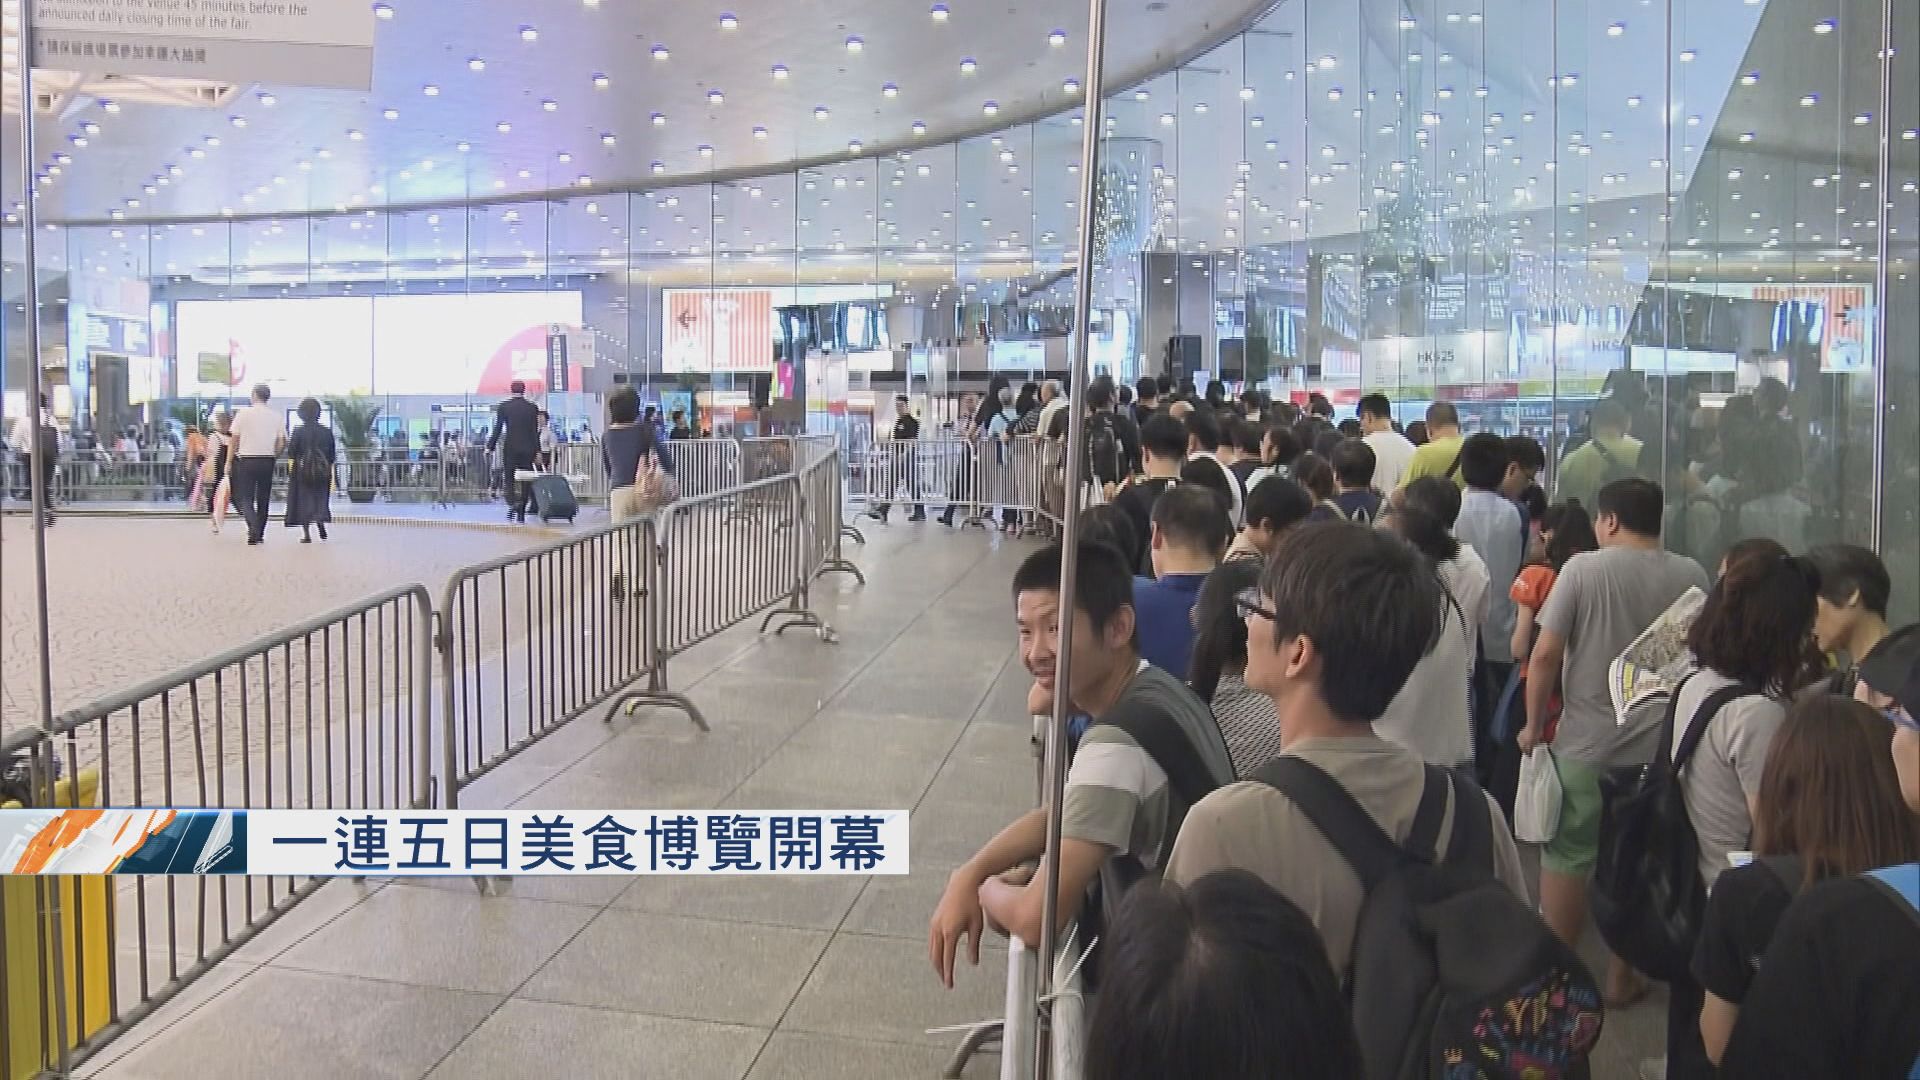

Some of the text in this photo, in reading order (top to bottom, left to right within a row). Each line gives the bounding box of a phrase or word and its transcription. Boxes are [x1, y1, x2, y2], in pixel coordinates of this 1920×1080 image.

[201, 0, 246, 13] minutes
[249, 1, 286, 14] before
[289, 3, 308, 16] the
[99, 9, 122, 23] daily
[127, 11, 164, 27] closing
[167, 14, 192, 28] time
[195, 15, 206, 28] of
[209, 16, 227, 30] the
